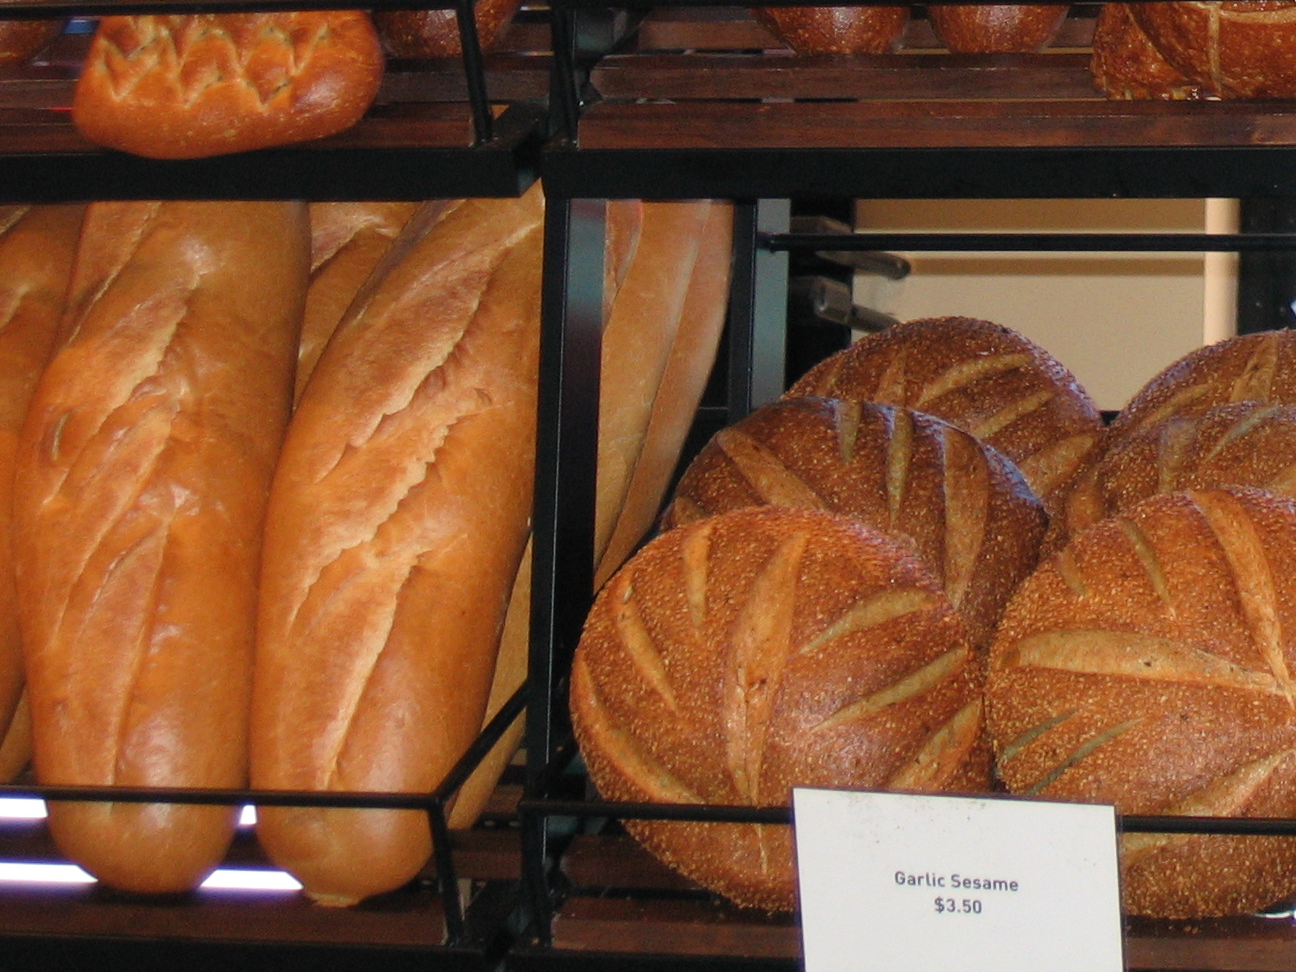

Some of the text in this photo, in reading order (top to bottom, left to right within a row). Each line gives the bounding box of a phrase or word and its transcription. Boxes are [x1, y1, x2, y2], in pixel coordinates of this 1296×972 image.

[894, 871, 1019, 891] Garlic Sesame
[934, 897, 982, 914] $3.50
